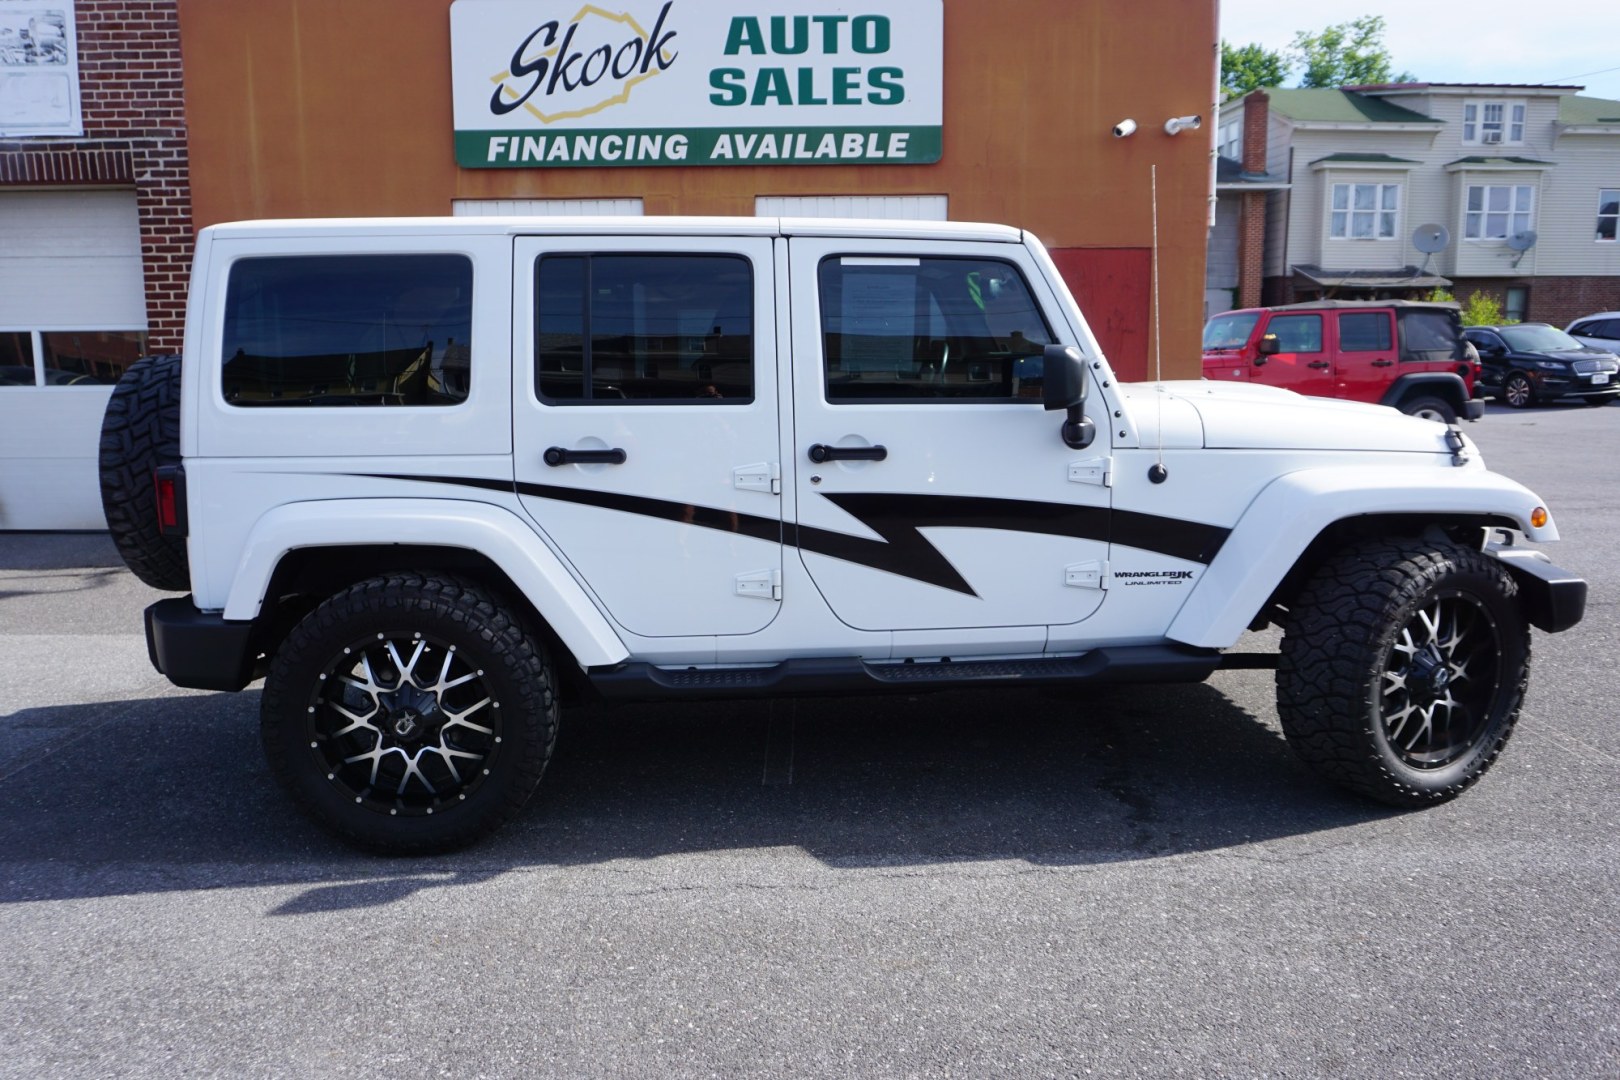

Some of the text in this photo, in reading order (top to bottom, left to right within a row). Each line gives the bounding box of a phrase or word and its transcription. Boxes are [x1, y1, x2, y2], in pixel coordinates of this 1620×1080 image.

[723, 15, 891, 55] AUTO
[490, 1, 678, 115] Skook
[708, 66, 905, 107] SALES
[487, 132, 910, 162] FINANCING AVAILABLE
